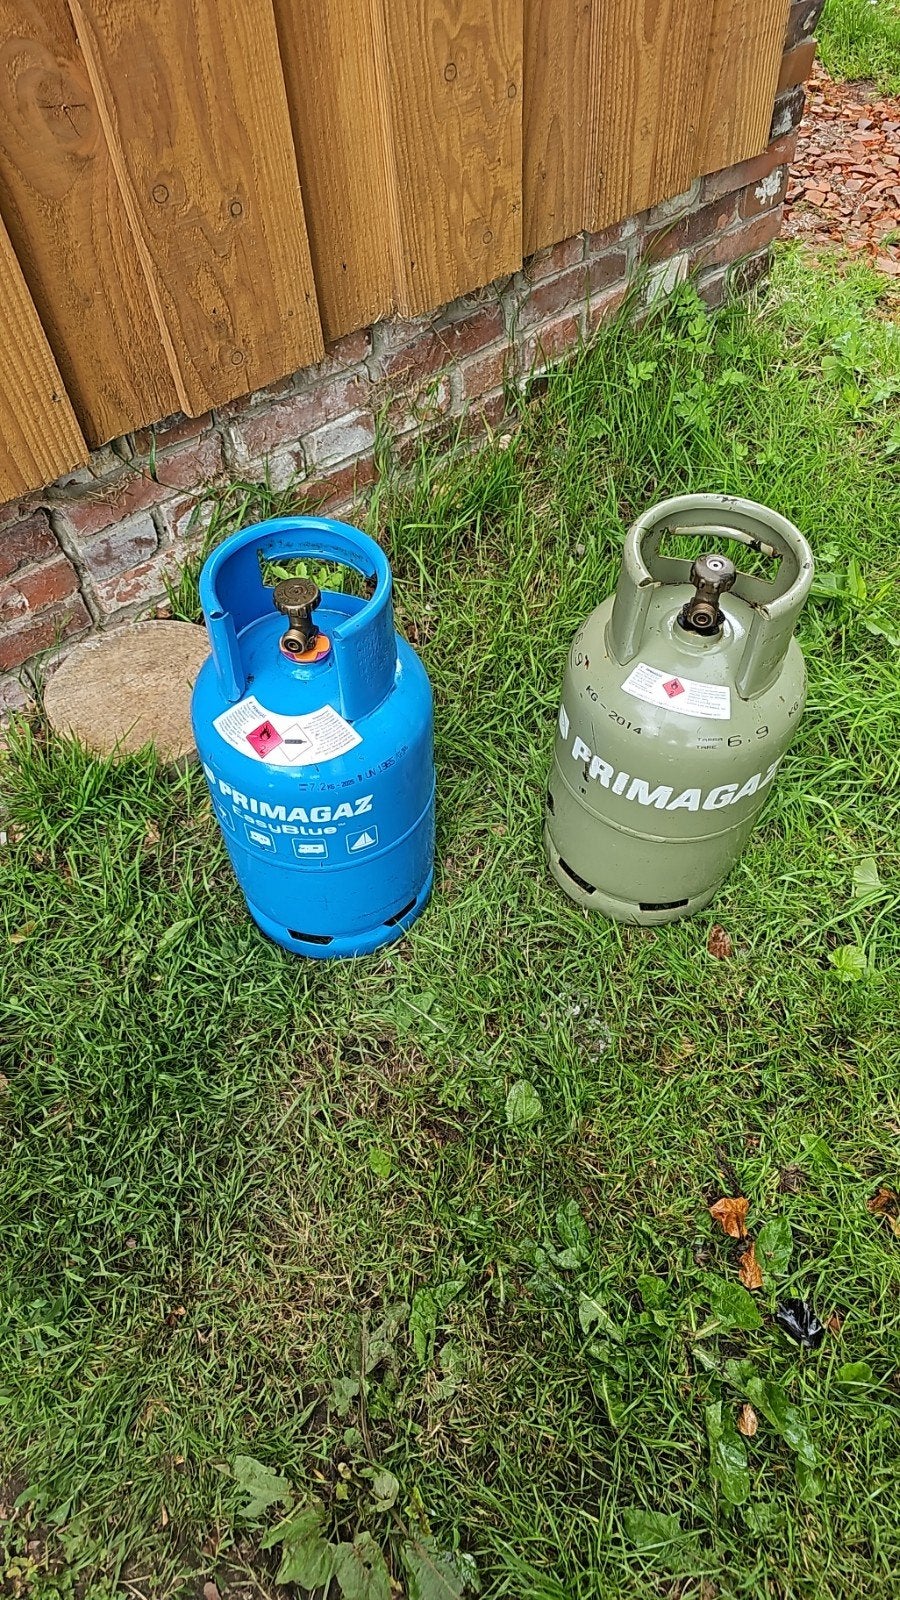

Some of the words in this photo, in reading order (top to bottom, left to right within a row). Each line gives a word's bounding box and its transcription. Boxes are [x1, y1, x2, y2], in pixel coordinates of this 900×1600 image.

[727, 725, 769, 747] 6.9
[571, 735, 785, 811] PRIMAGAZ
[218, 779, 374, 823] PRIMAGAZ
